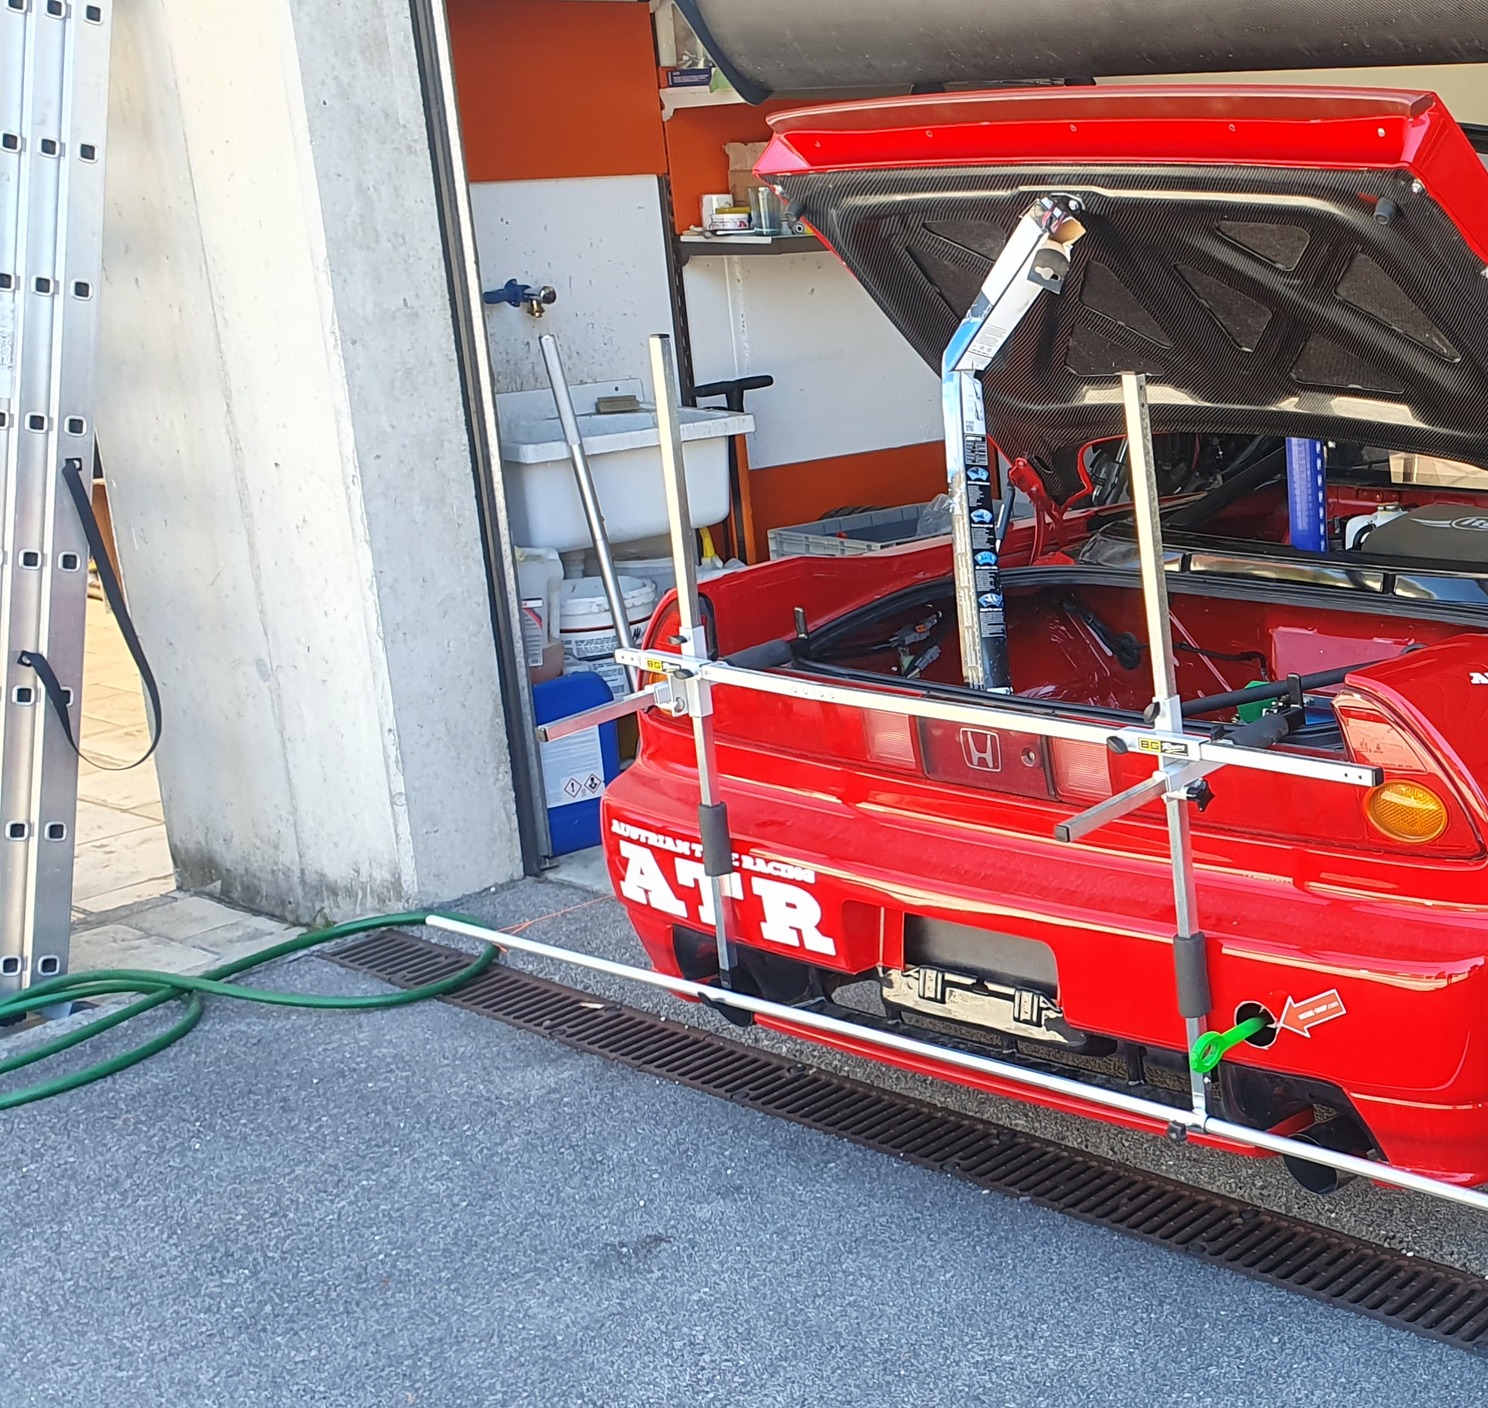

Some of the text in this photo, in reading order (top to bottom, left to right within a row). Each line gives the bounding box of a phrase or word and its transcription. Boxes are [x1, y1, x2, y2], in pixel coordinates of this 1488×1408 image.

[647, 660, 660, 669] BG
[1141, 740, 1159, 750] BG
[611, 819, 816, 884] AUSTRIAN TE RACING
[619, 840, 837, 957] ATR
